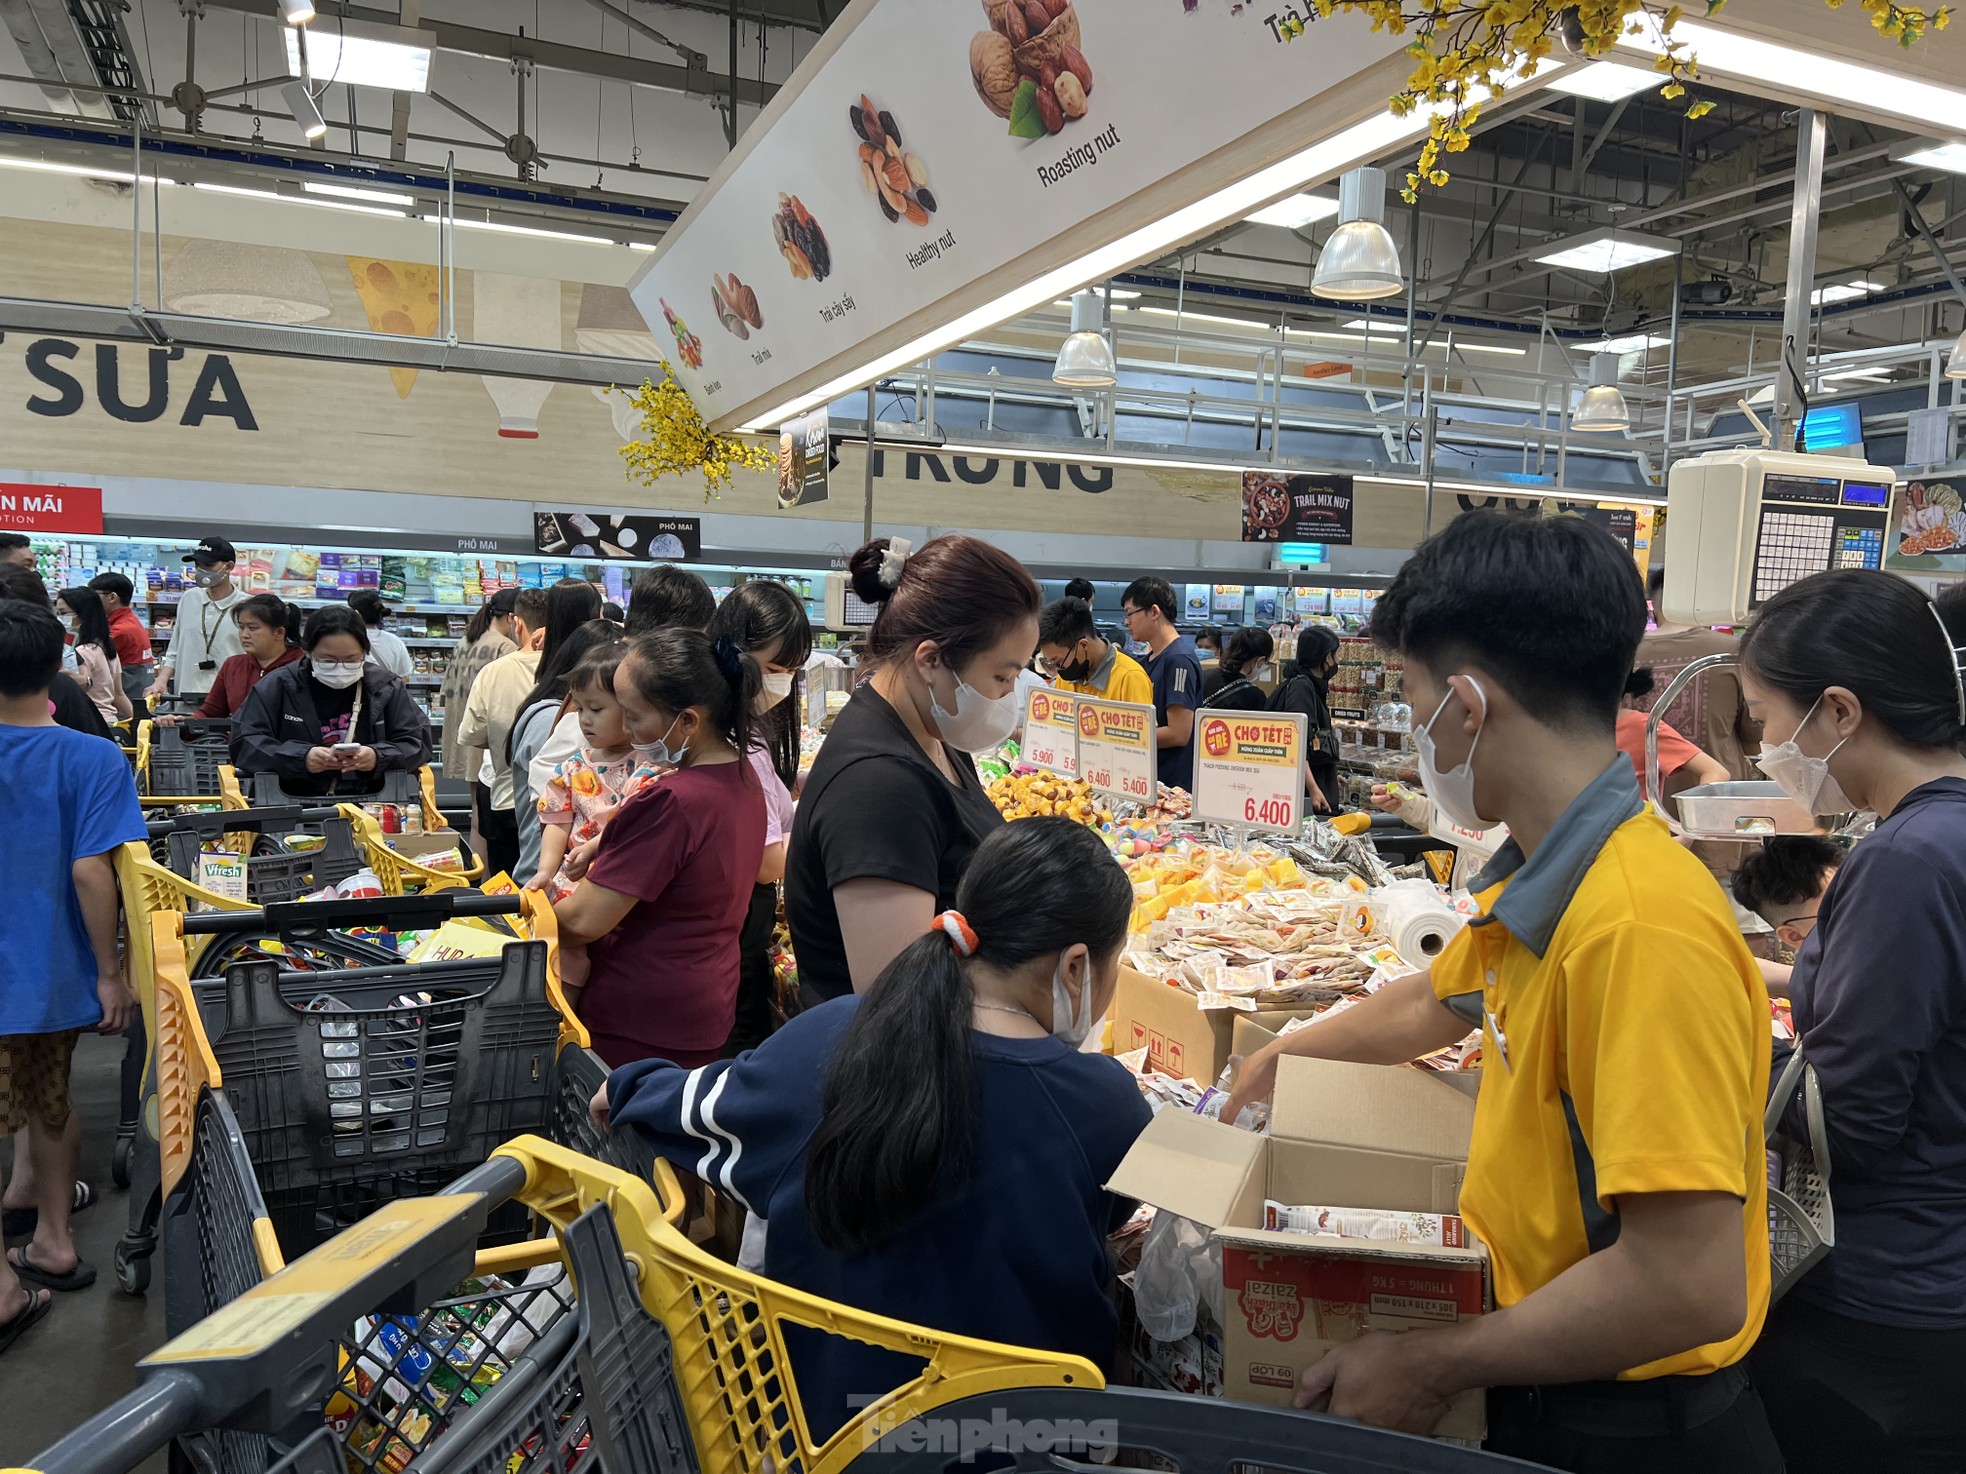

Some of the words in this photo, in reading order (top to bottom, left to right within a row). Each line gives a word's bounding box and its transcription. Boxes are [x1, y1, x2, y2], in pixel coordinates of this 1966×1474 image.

[1037, 146, 1097, 188] Roasting
[1094, 123, 1121, 154] nut
[906, 239, 941, 270] Healthy
[937, 228, 957, 253] nut
[23, 493, 63, 513] MÃI
[1293, 494, 1317, 508] TRAIL
[1317, 494, 1333, 507] MIX
[1333, 495, 1351, 510] NUT
[659, 521, 676, 531] PHÔ
[678, 523, 693, 531] MAI
[458, 538, 477, 550] PHÔ
[479, 540, 498, 551] MAI
[1101, 711, 1120, 727] CHỢ
[1120, 712, 1136, 729] TẾT
[1234, 725, 1260, 743] CHỢ
[1262, 724, 1283, 743] TẾT
[1032, 749, 1053, 765] 5.900
[1088, 770, 1111, 787] 6.400
[1123, 777, 1147, 795] 5.400
[1244, 797, 1291, 826] 6.400
[207, 864, 240, 877] Vfresh
[1372, 1275, 1388, 1288] KG
[1246, 1281, 1297, 1300] zaizai
[1374, 1297, 1390, 1306] mm
[1392, 1298, 1406, 1309] 150
[1439, 1302, 1454, 1313] 305
[1277, 1367, 1291, 1378] 09
